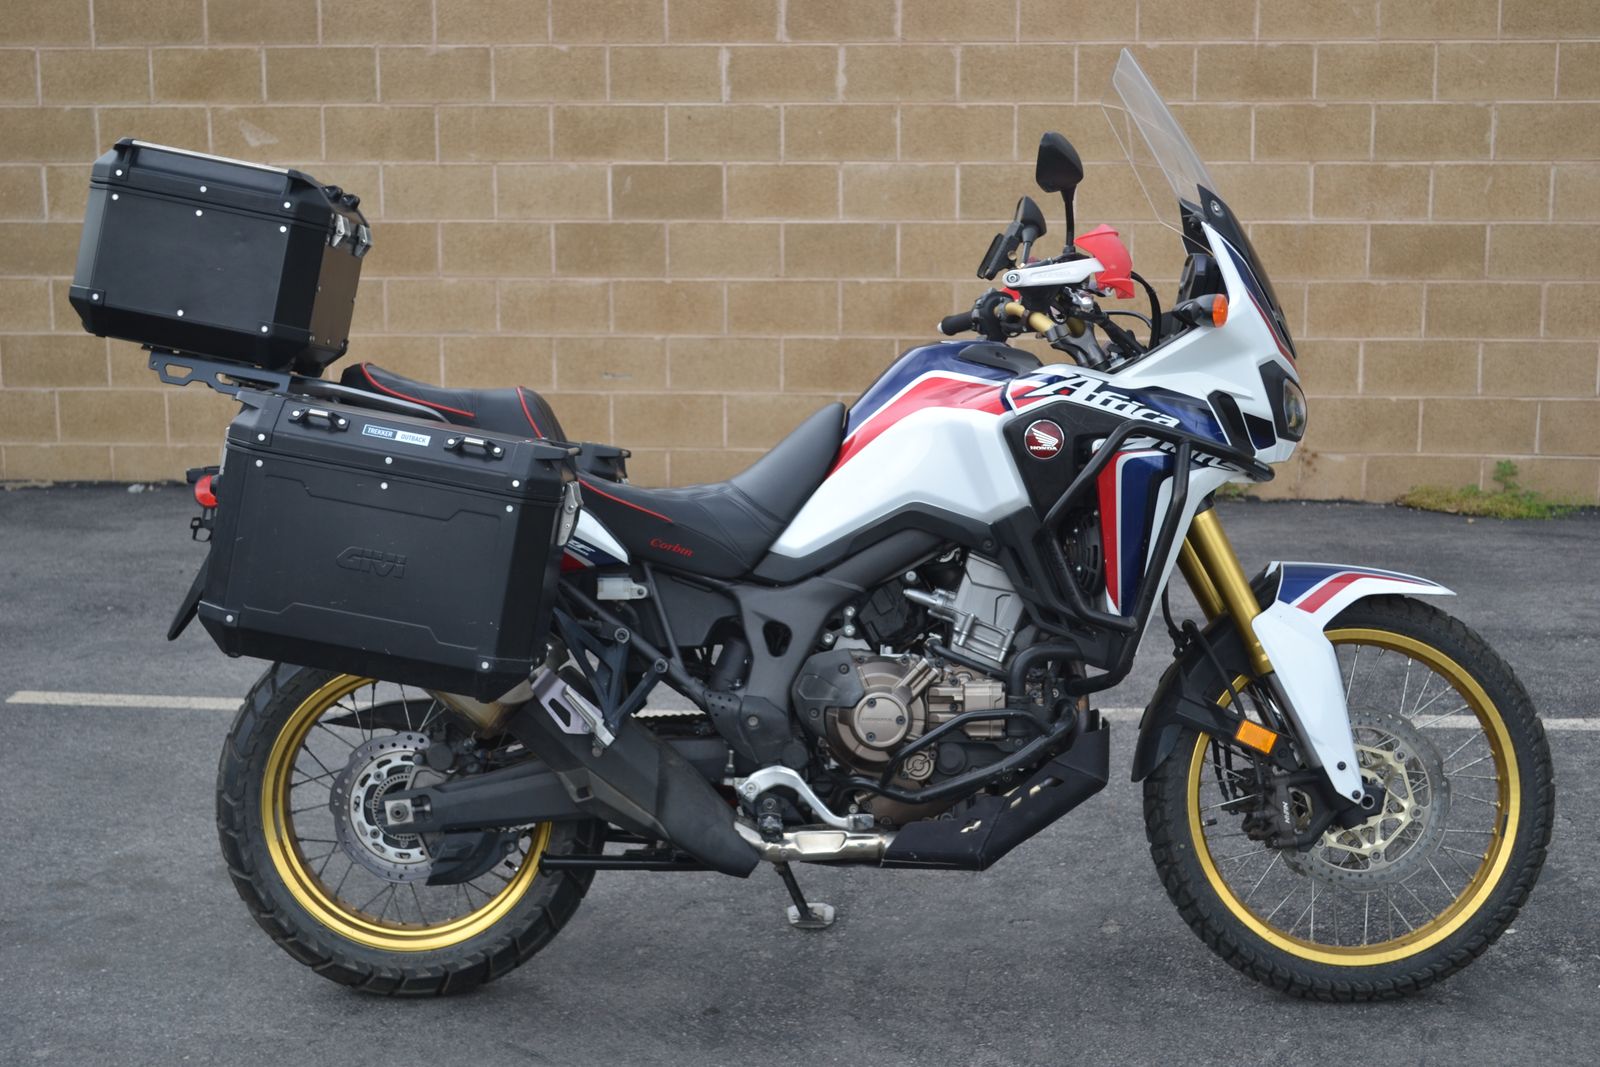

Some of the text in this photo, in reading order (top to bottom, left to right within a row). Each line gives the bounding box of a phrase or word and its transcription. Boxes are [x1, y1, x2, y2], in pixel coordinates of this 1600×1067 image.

[1024, 374, 1181, 428] Africa
[367, 427, 427, 443] TREKKER OUTBACK
[650, 538, 695, 557] Corbin
[336, 546, 407, 579] GIVI
